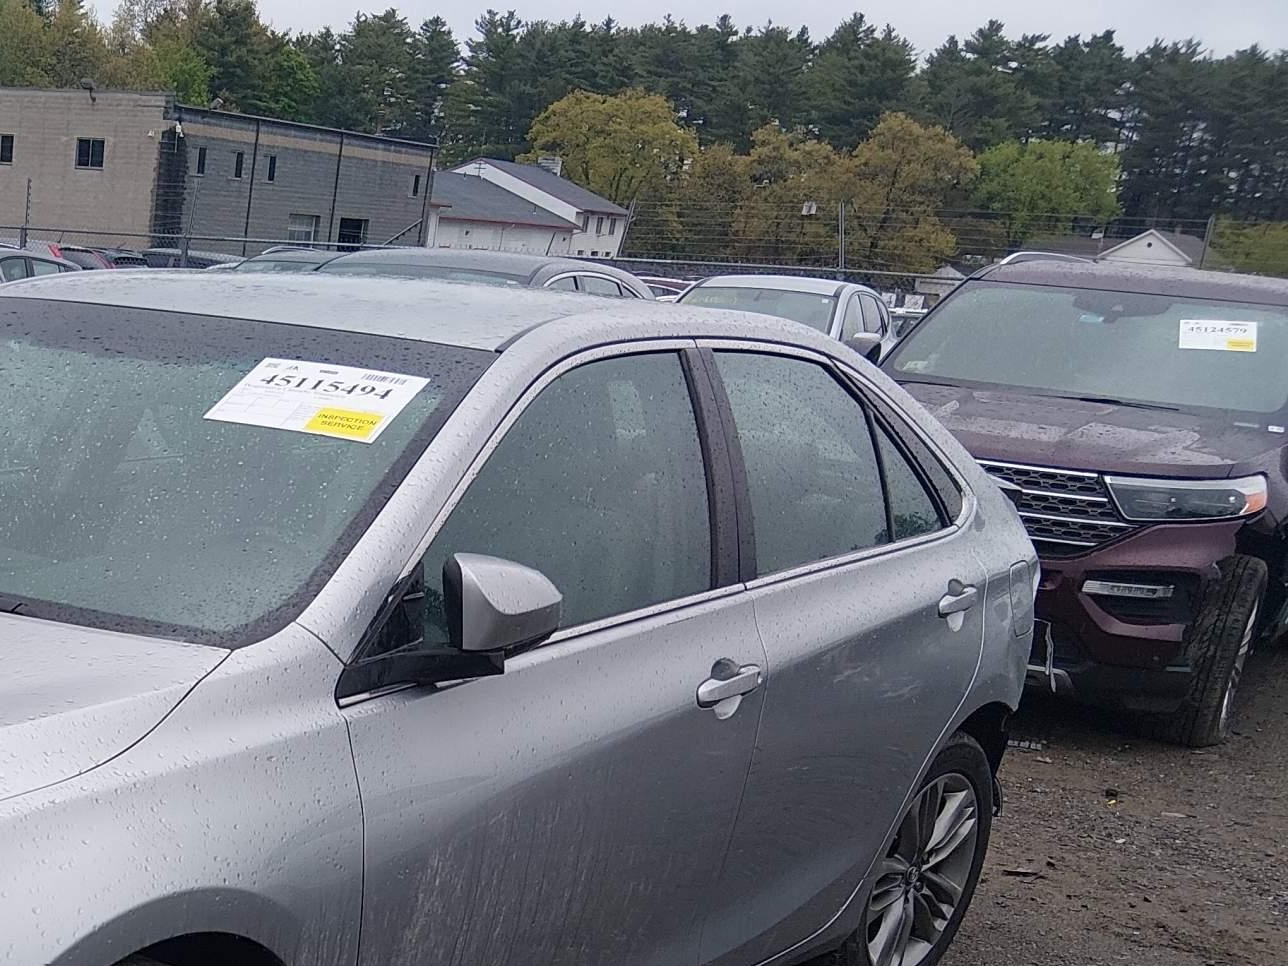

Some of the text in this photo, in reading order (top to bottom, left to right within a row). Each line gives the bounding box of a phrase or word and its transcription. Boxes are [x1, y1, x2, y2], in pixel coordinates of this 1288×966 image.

[261, 374, 393, 400] 45115494
[318, 413, 377, 426] INSPECTION
[320, 420, 365, 431] SERVICE
